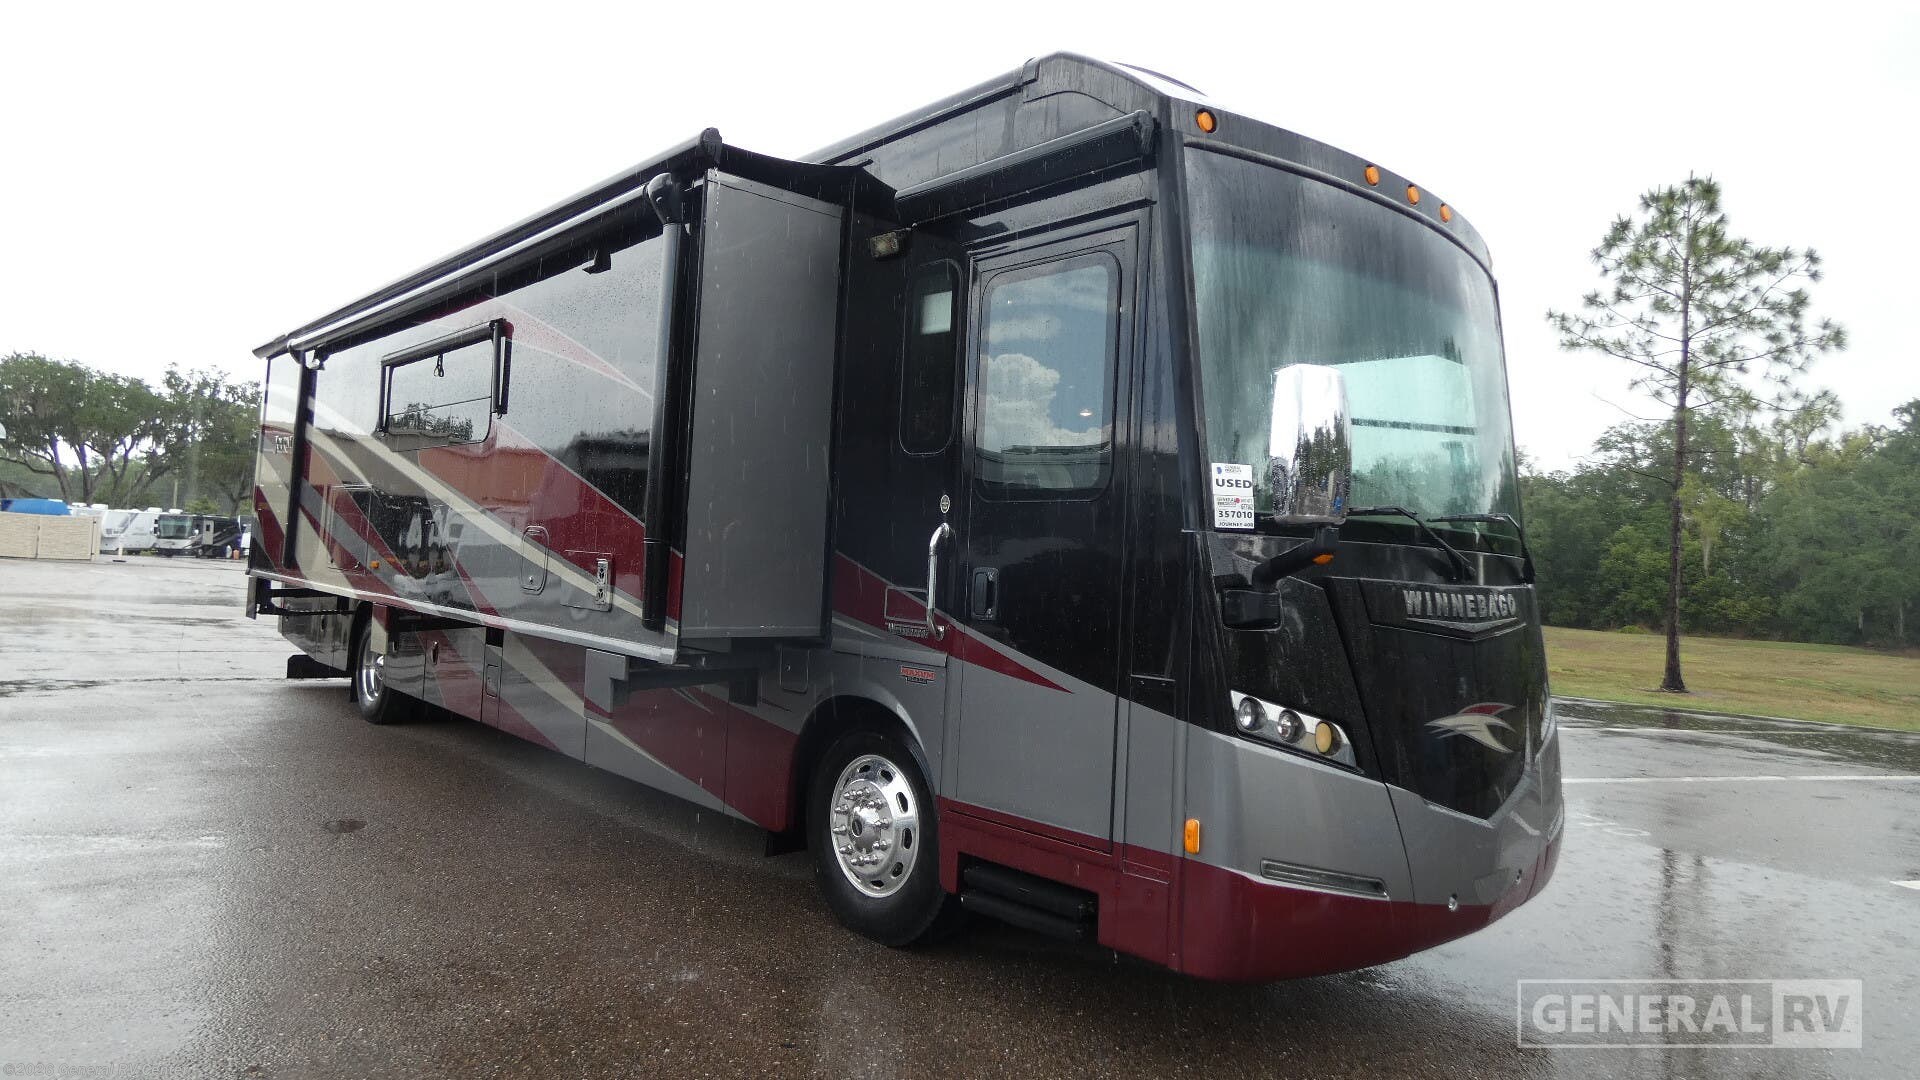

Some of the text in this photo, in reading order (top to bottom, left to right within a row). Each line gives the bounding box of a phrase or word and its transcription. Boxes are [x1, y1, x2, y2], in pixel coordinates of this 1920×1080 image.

[1215, 478, 1252, 489] USED
[1218, 510, 1253, 519] 357010
[1403, 590, 1517, 618] WINNEBAGO
